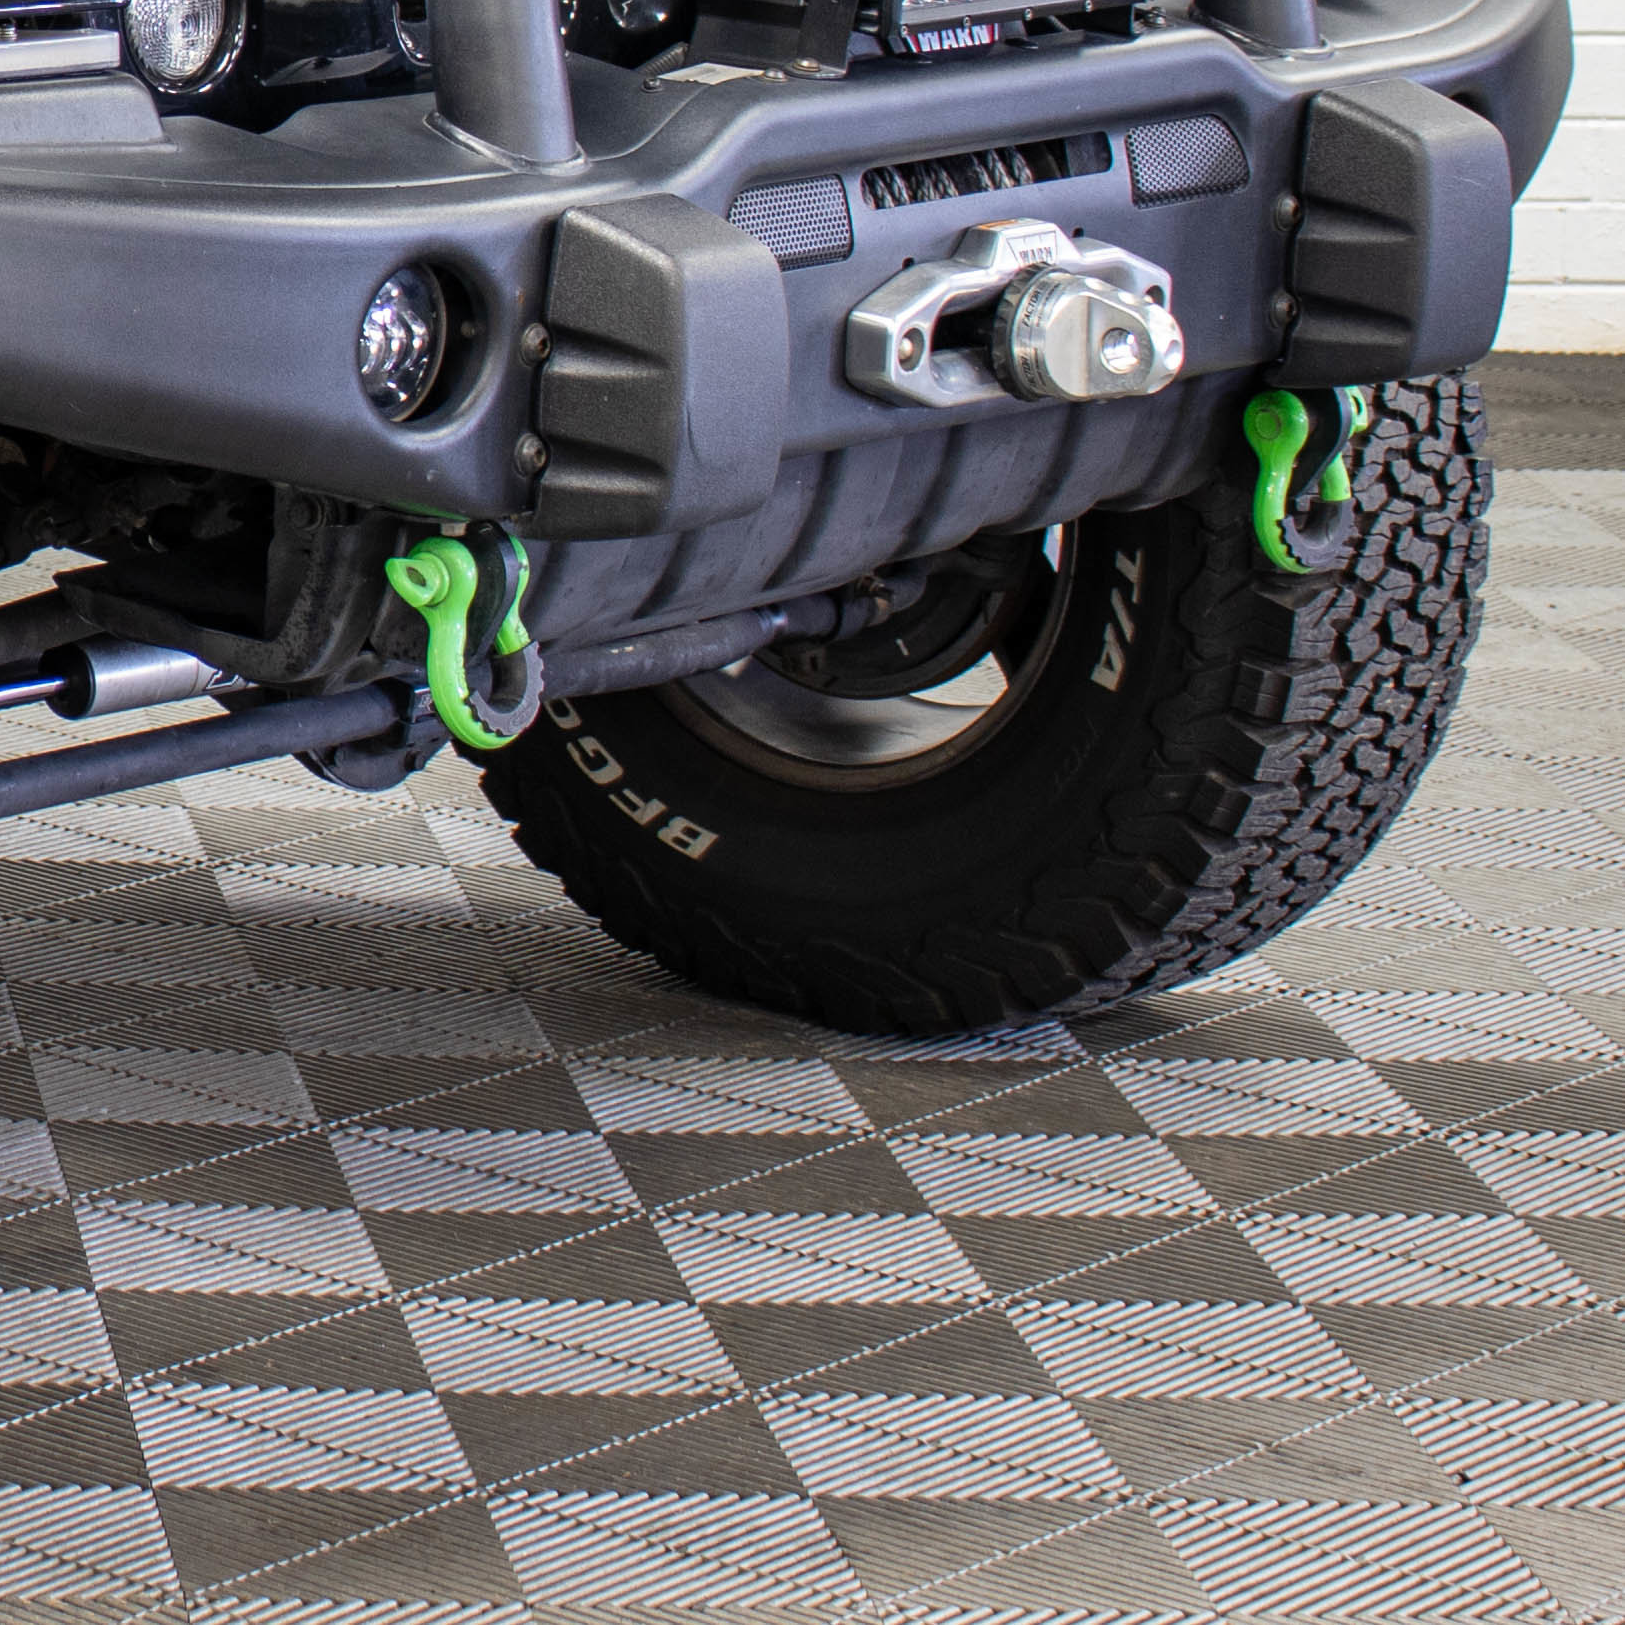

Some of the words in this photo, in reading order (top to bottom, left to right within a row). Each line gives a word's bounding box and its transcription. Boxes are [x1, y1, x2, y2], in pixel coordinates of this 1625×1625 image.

[917, 23, 993, 53] WARN
[1018, 246, 1053, 264] WARN
[1090, 546, 1144, 693] T/A
